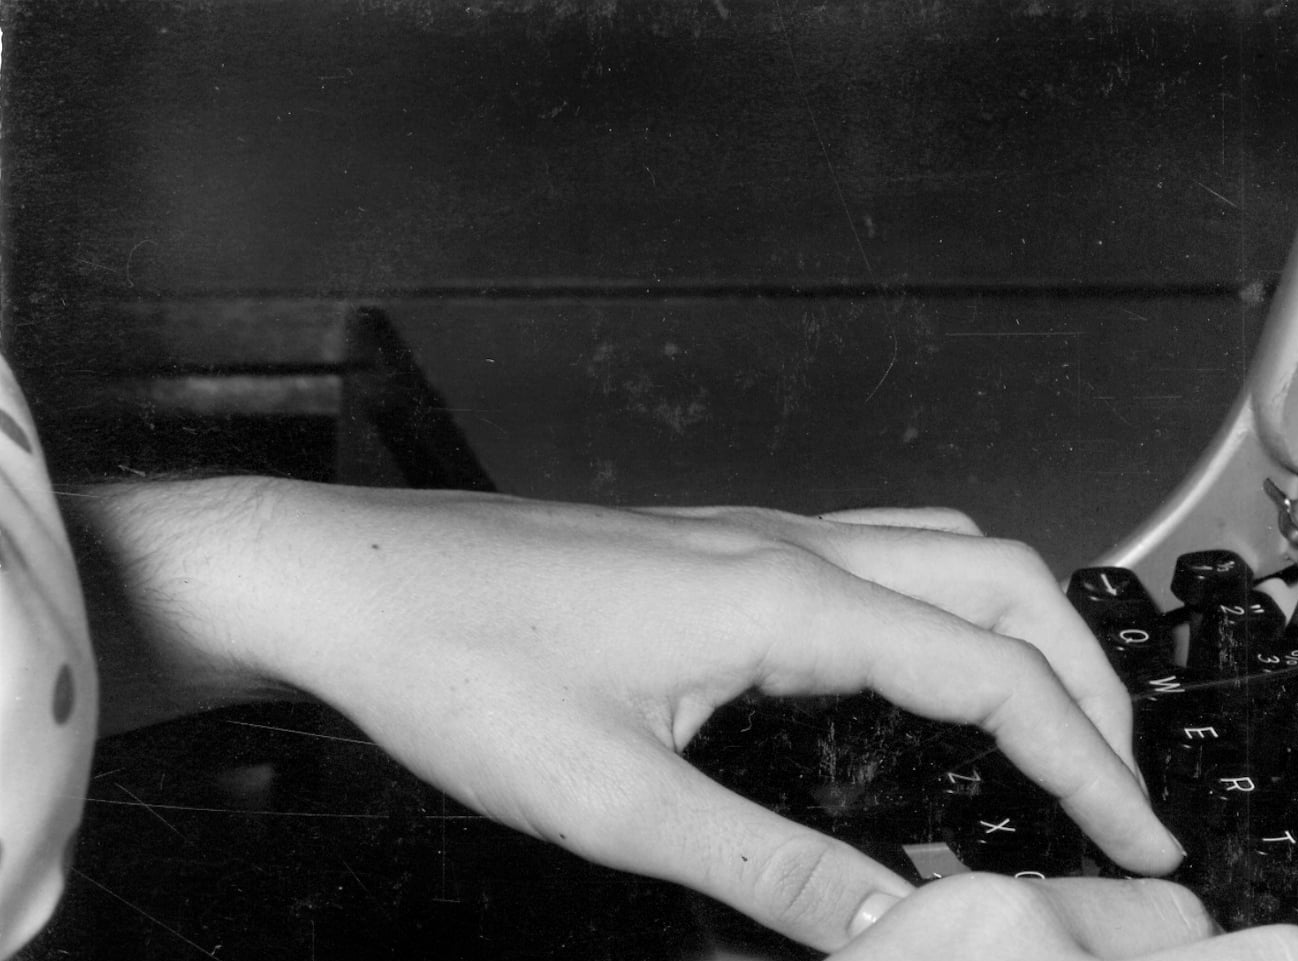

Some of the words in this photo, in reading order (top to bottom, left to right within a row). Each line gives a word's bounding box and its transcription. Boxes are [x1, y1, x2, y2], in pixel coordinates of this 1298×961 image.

[1219, 603, 1246, 616] 2
[1119, 628, 1150, 644] Q
[1256, 652, 1281, 665] 3
[1149, 674, 1187, 694] W
[1183, 725, 1220, 740] E
[946, 768, 983, 786] Z
[1218, 776, 1256, 792] R
[979, 816, 1017, 834] X
[1261, 829, 1297, 844] T
